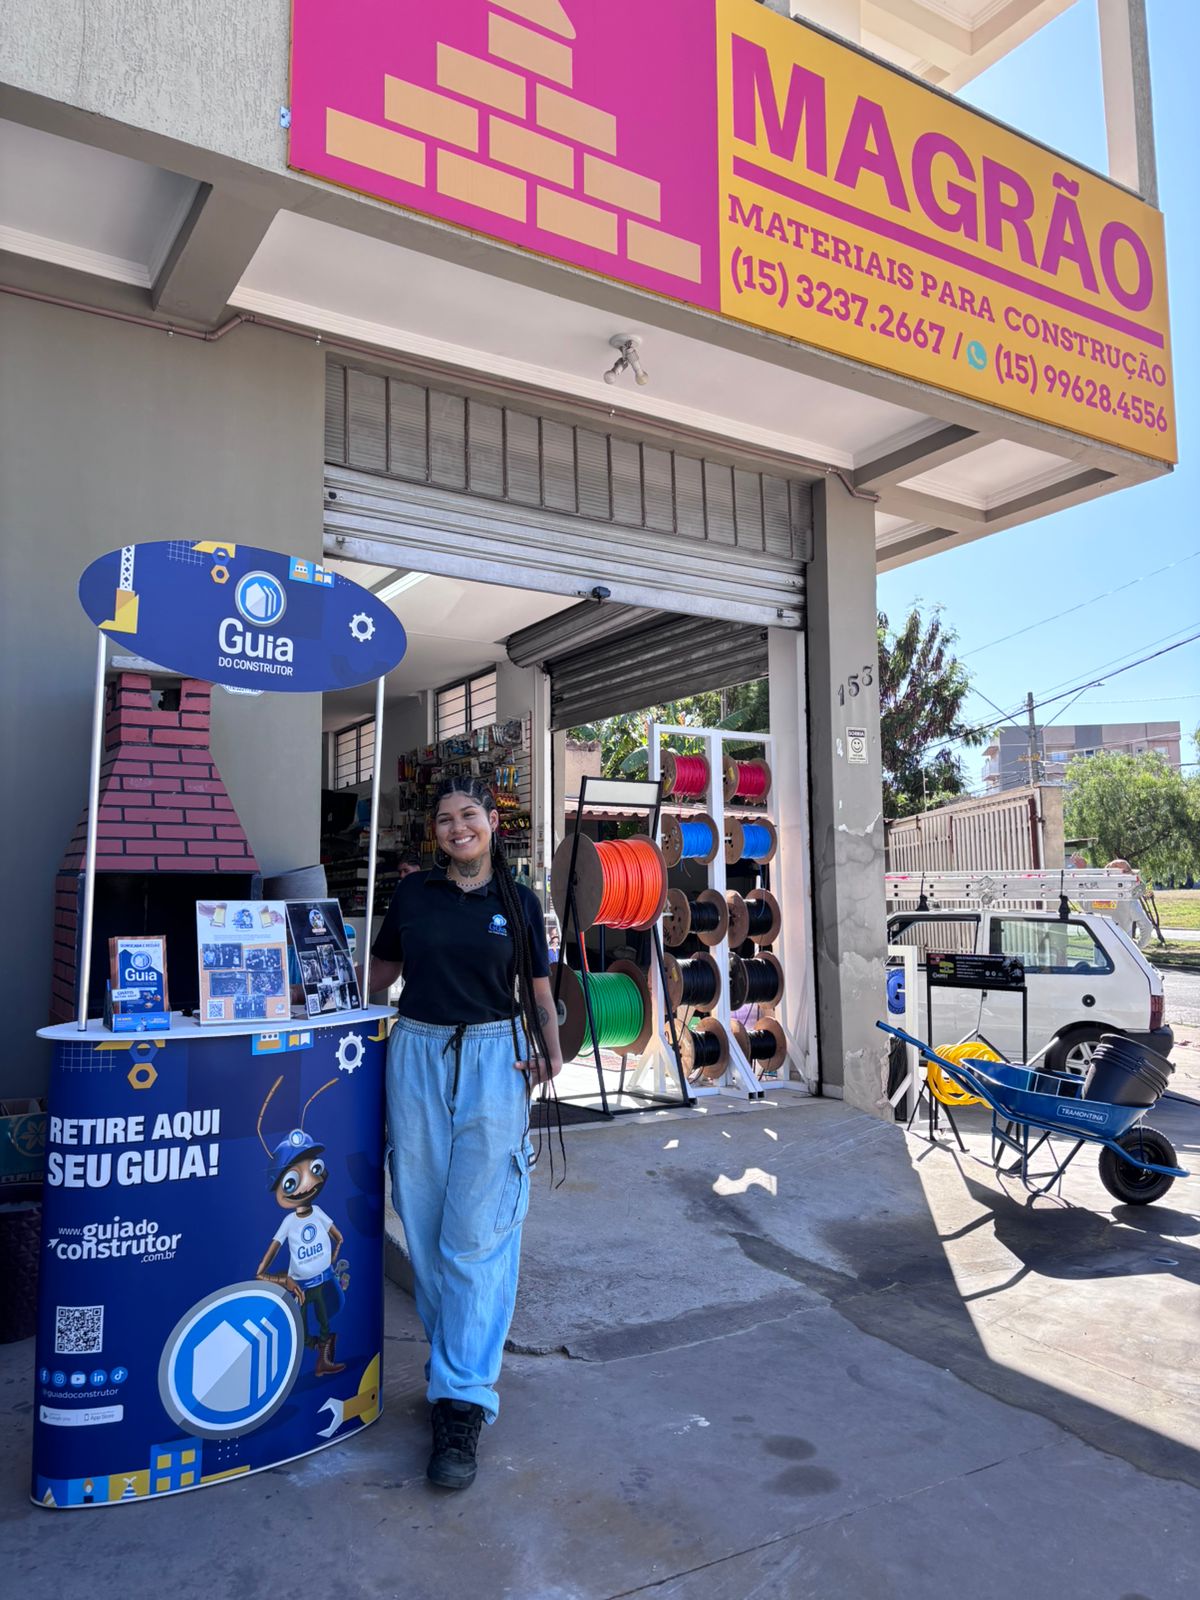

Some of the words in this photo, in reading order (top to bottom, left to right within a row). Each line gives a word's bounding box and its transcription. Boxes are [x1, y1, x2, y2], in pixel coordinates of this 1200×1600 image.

[731, 33, 1153, 312] MAGRÃO
[728, 194, 914, 291] MATERIAIS
[920, 270, 995, 323] PARA
[1004, 305, 1167, 387] CONSTRUÇÃO
[731, 246, 789, 308] (15)
[796, 274, 946, 355] 3237.2667
[995, 344, 1038, 395] (15)
[1044, 368, 1168, 432] 99628.4556
[218, 617, 294, 662] Guia
[218, 656, 232, 668] DO
[233, 658, 293, 676] CONSTRUTOR
[838, 664, 873, 706] 153
[125, 968, 157, 981] Guia
[50, 1116, 144, 1145] RETIRE
[152, 1109, 220, 1140] AQUI
[1061, 1108, 1103, 1121] TRAMONTINA
[48, 1152, 112, 1188] SEU
[116, 1143, 219, 1186] GUIA!
[57, 1233, 182, 1260] construtor
[298, 1243, 323, 1259] Guia
